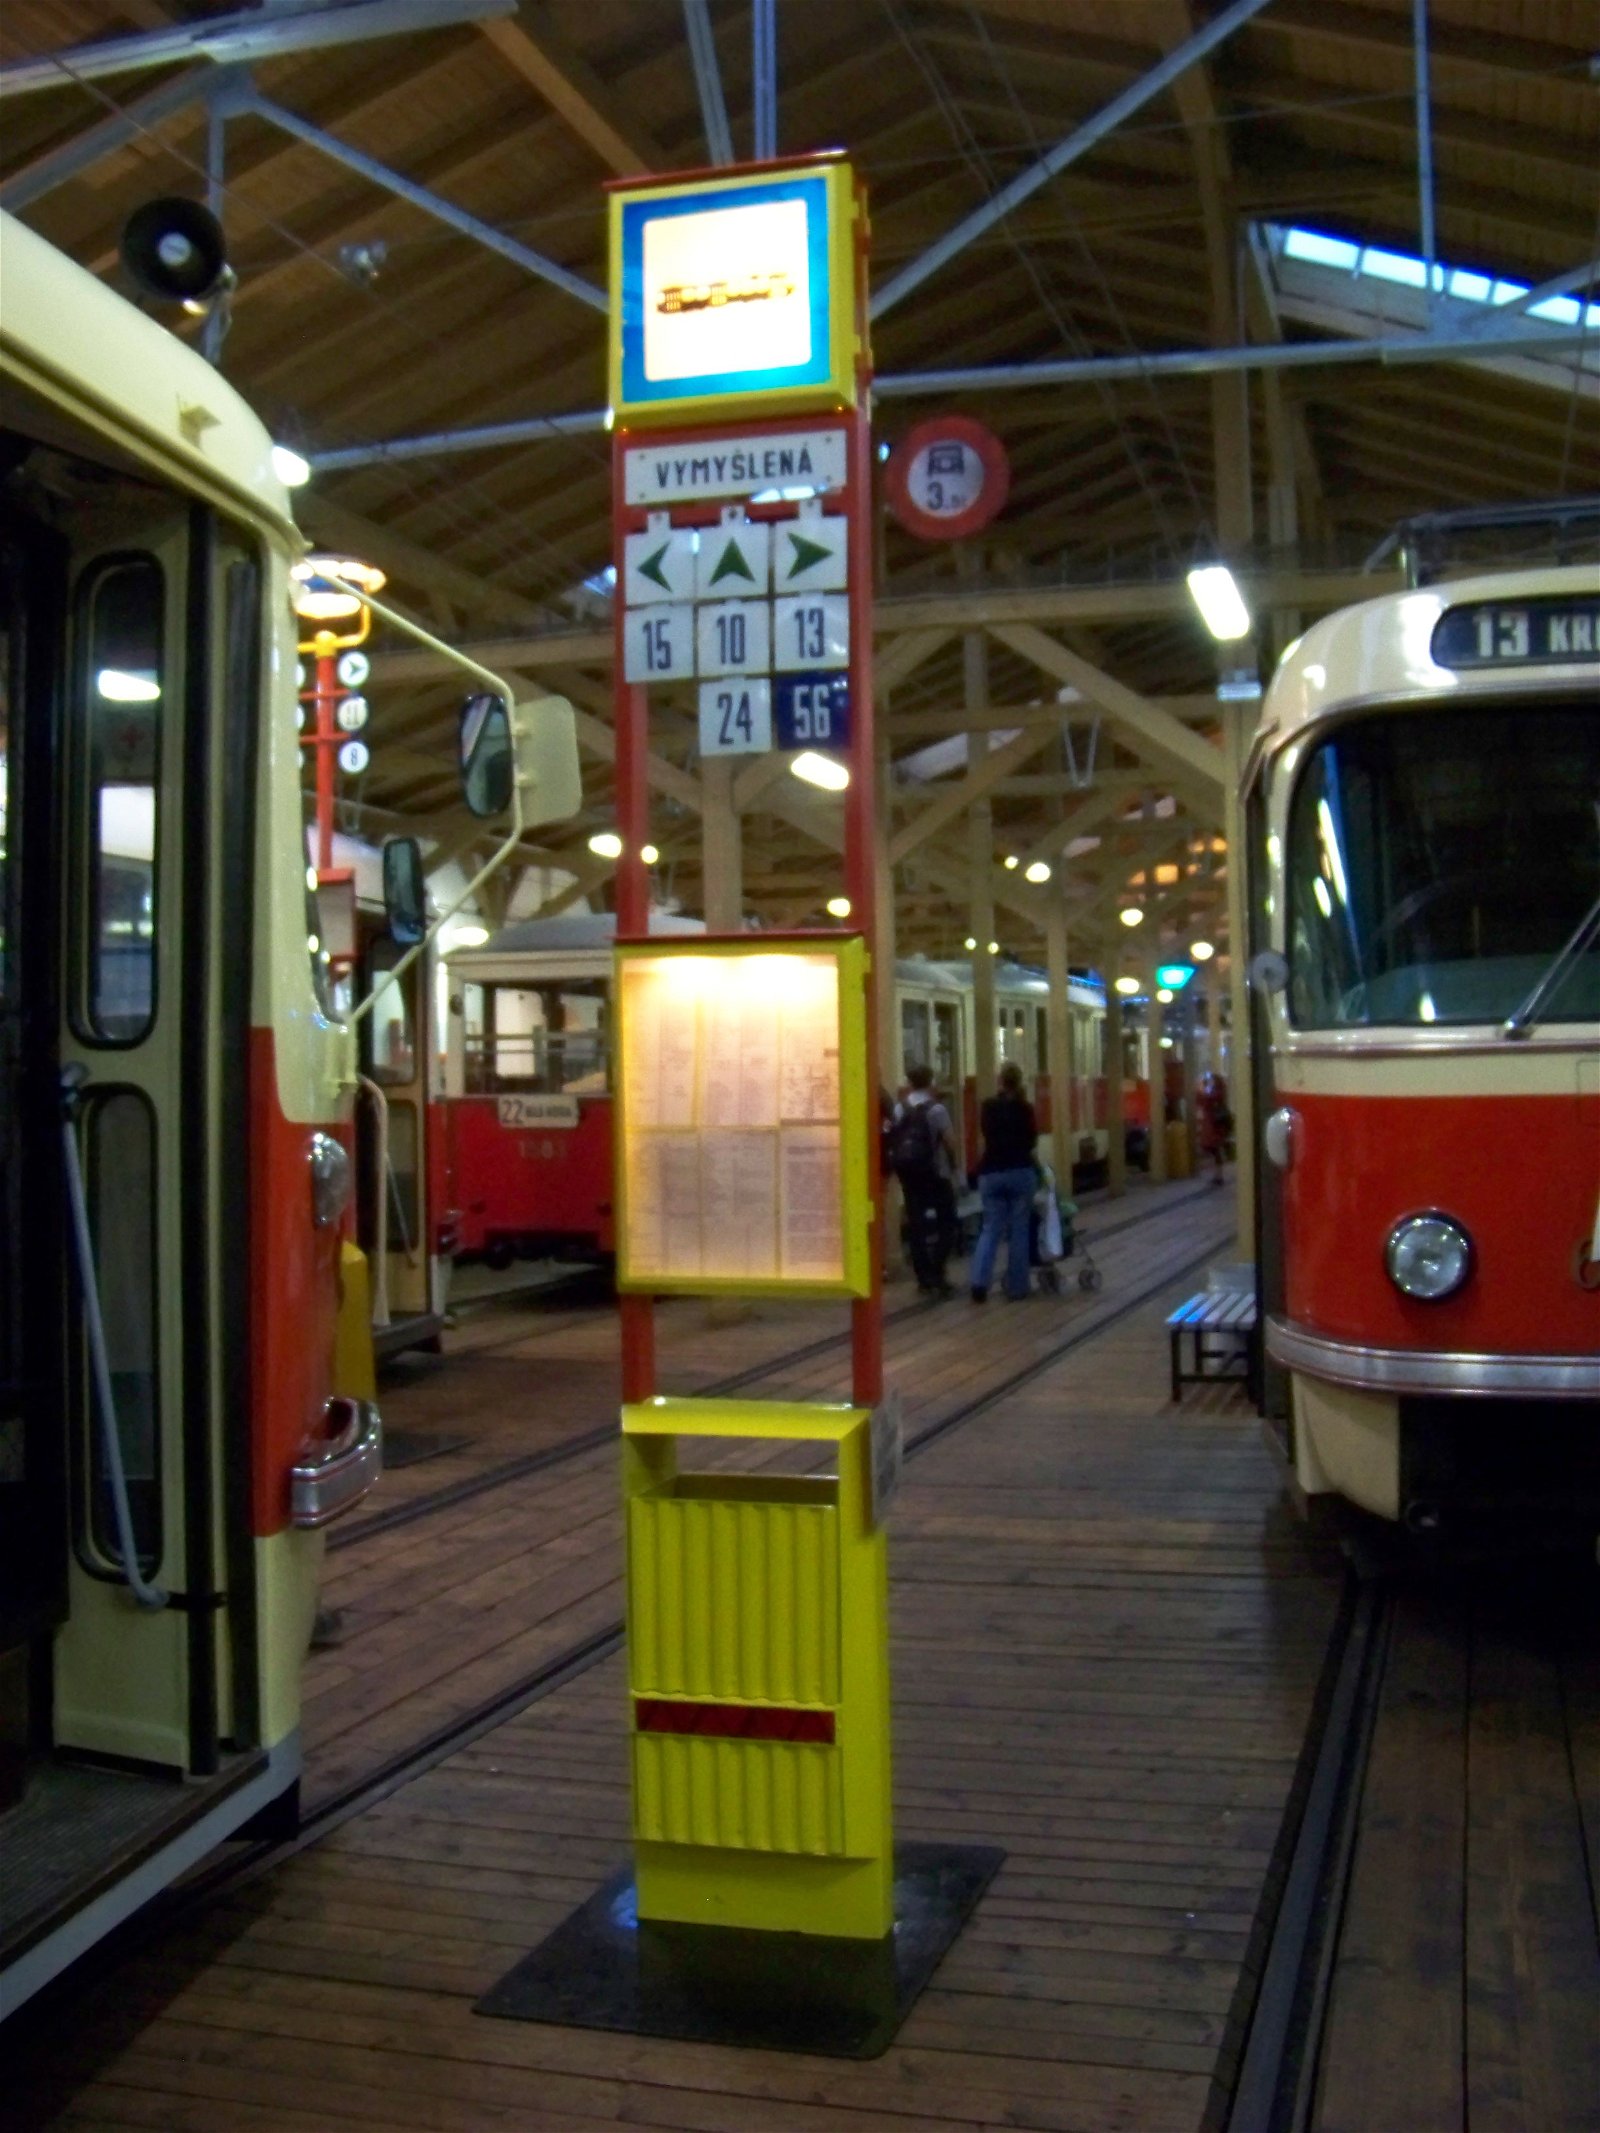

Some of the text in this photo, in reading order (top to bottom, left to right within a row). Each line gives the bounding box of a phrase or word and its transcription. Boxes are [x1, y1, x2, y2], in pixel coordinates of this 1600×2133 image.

[927, 481, 943, 511] 3
[643, 619, 671, 671] 15
[716, 613, 746, 665] 10
[795, 607, 826, 660] 13
[1472, 609, 1529, 657] 13
[718, 693, 753, 747] 24
[795, 684, 831, 740] 56
[501, 1099, 523, 1125] 22
